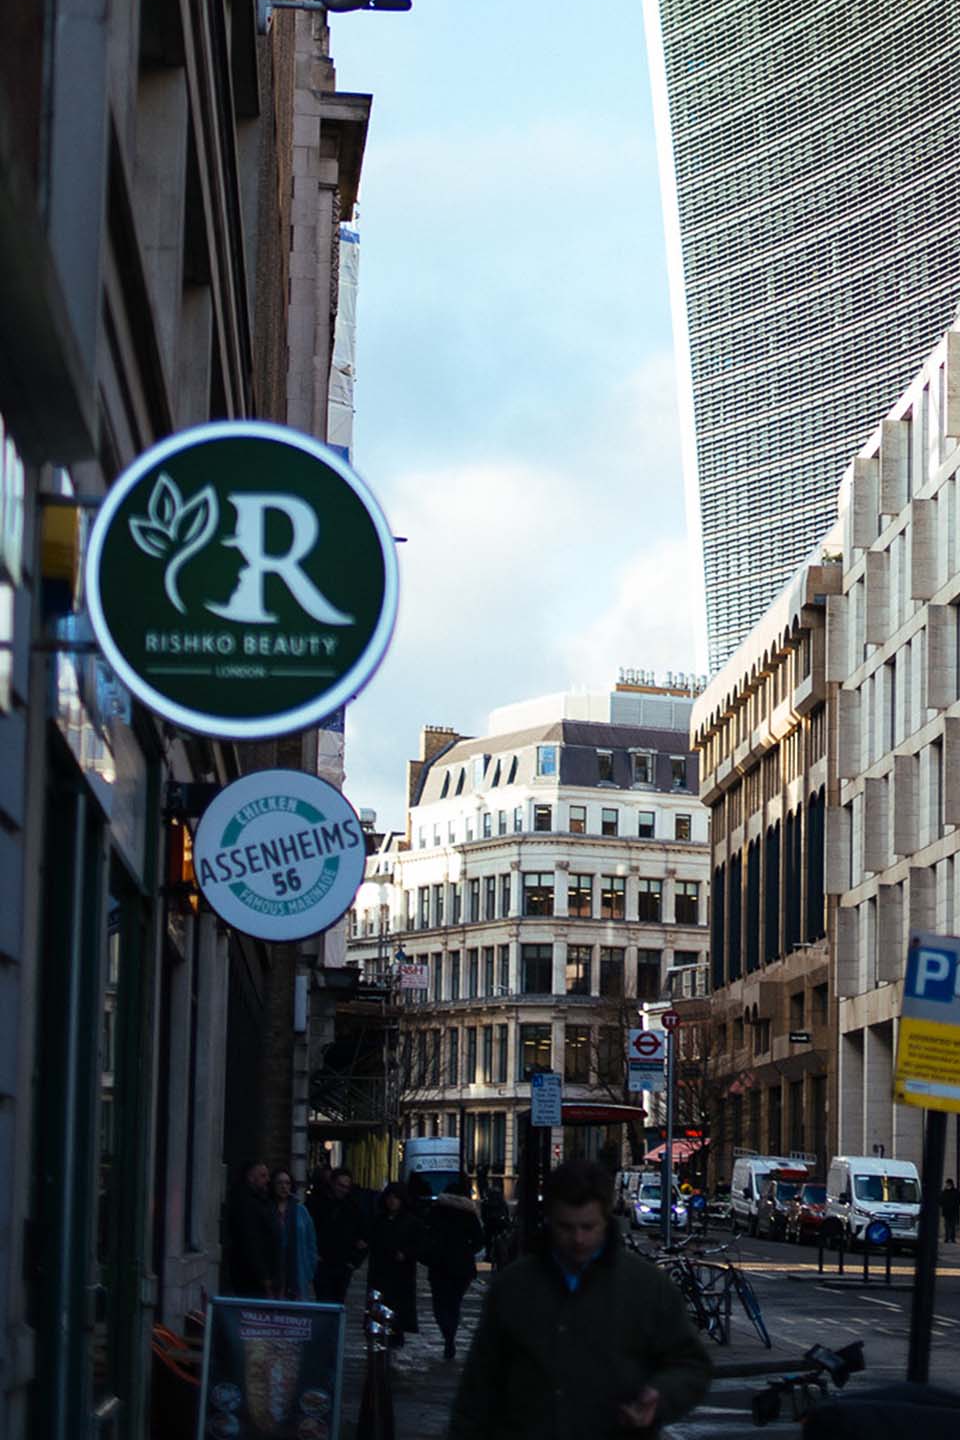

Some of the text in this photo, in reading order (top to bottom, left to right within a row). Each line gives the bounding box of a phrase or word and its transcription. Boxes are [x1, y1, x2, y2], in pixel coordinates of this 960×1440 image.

[203, 492, 355, 626] R
[145, 632, 339, 657] RISHKO BEAUTY
[236, 795, 298, 825] CHICKEN
[200, 818, 360, 888] ASSENHEIMS
[272, 867, 302, 897] 56
[239, 888, 285, 916] FAMOUS
[914, 951, 949, 995] P
[664, 1015, 678, 1025] TT
